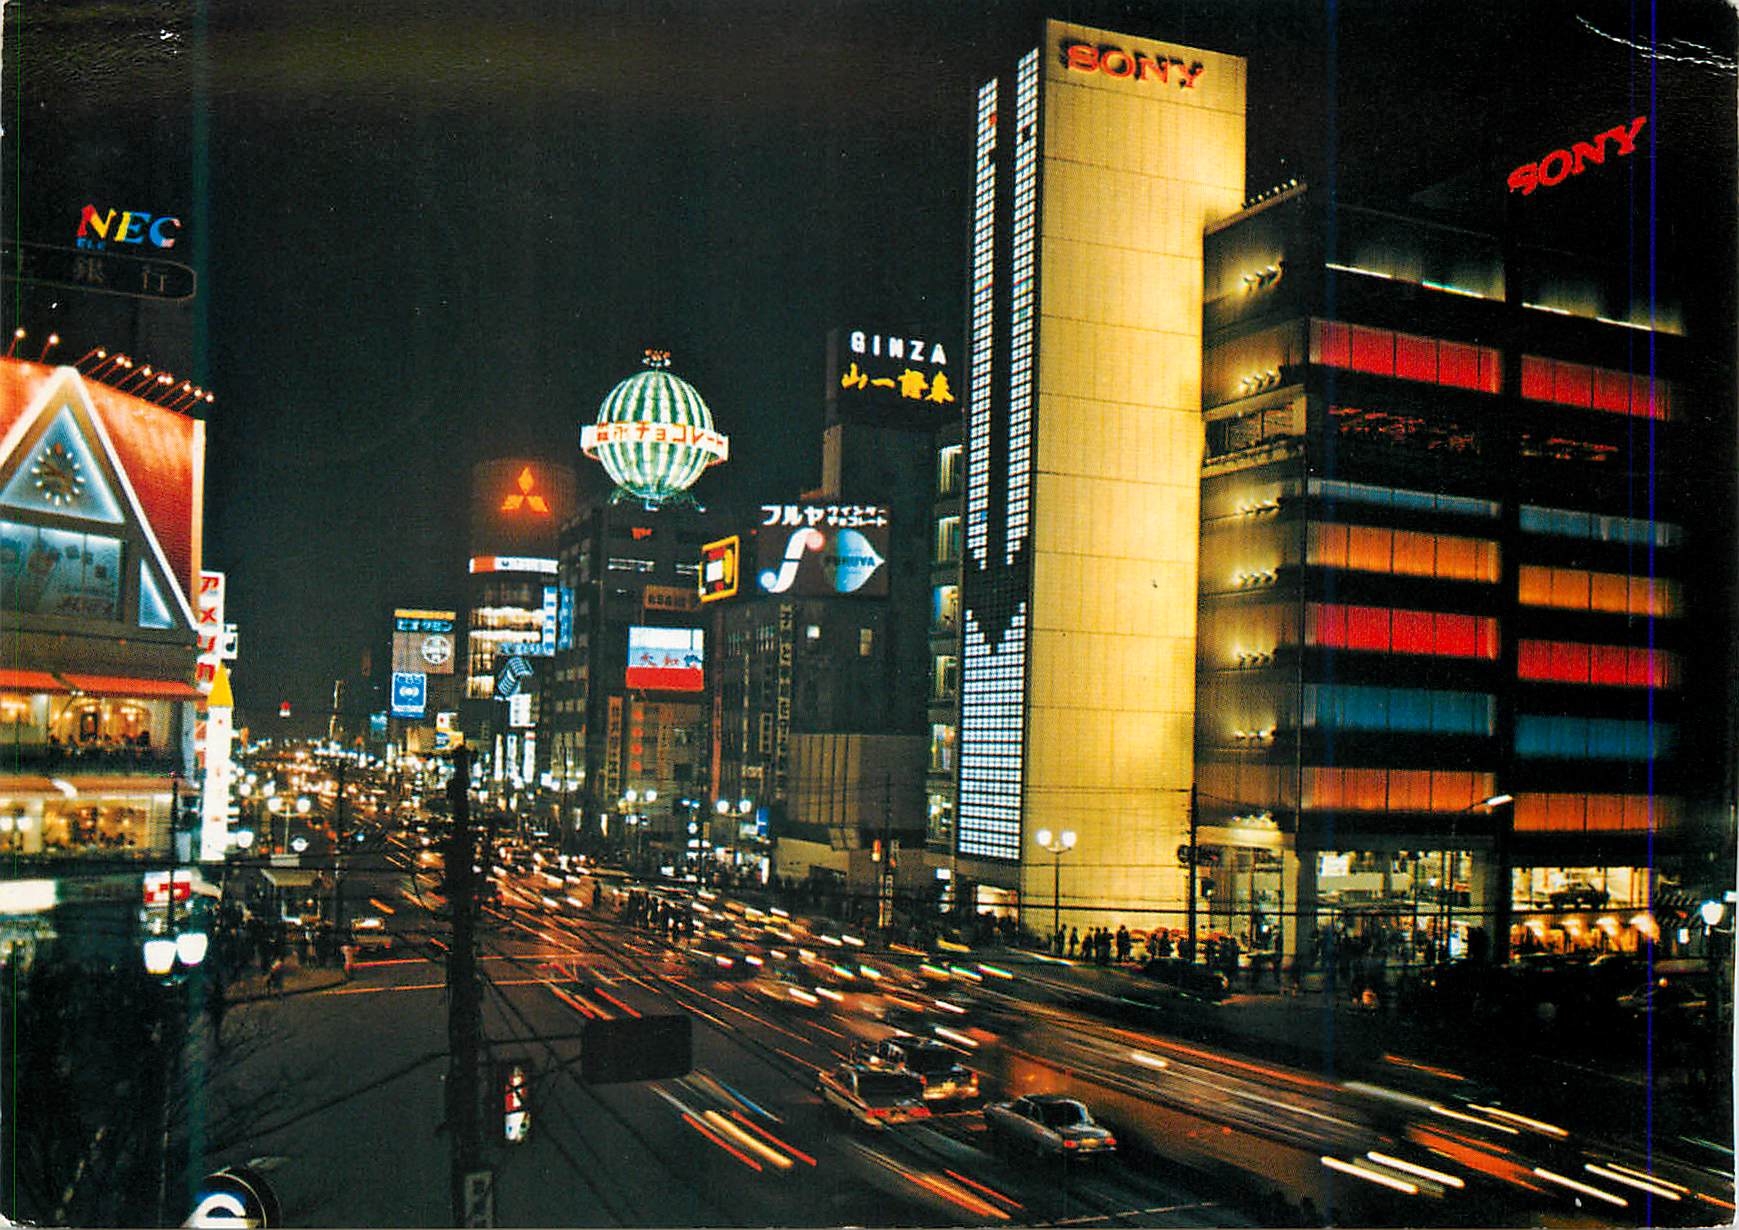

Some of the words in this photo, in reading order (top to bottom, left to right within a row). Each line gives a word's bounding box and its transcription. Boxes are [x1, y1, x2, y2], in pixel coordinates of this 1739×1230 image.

[1066, 43, 1206, 89] SONY
[1507, 116, 1647, 195] SONY
[76, 204, 183, 249] NEC
[850, 331, 947, 364] GINZA
[760, 505, 824, 527] フルヤ
